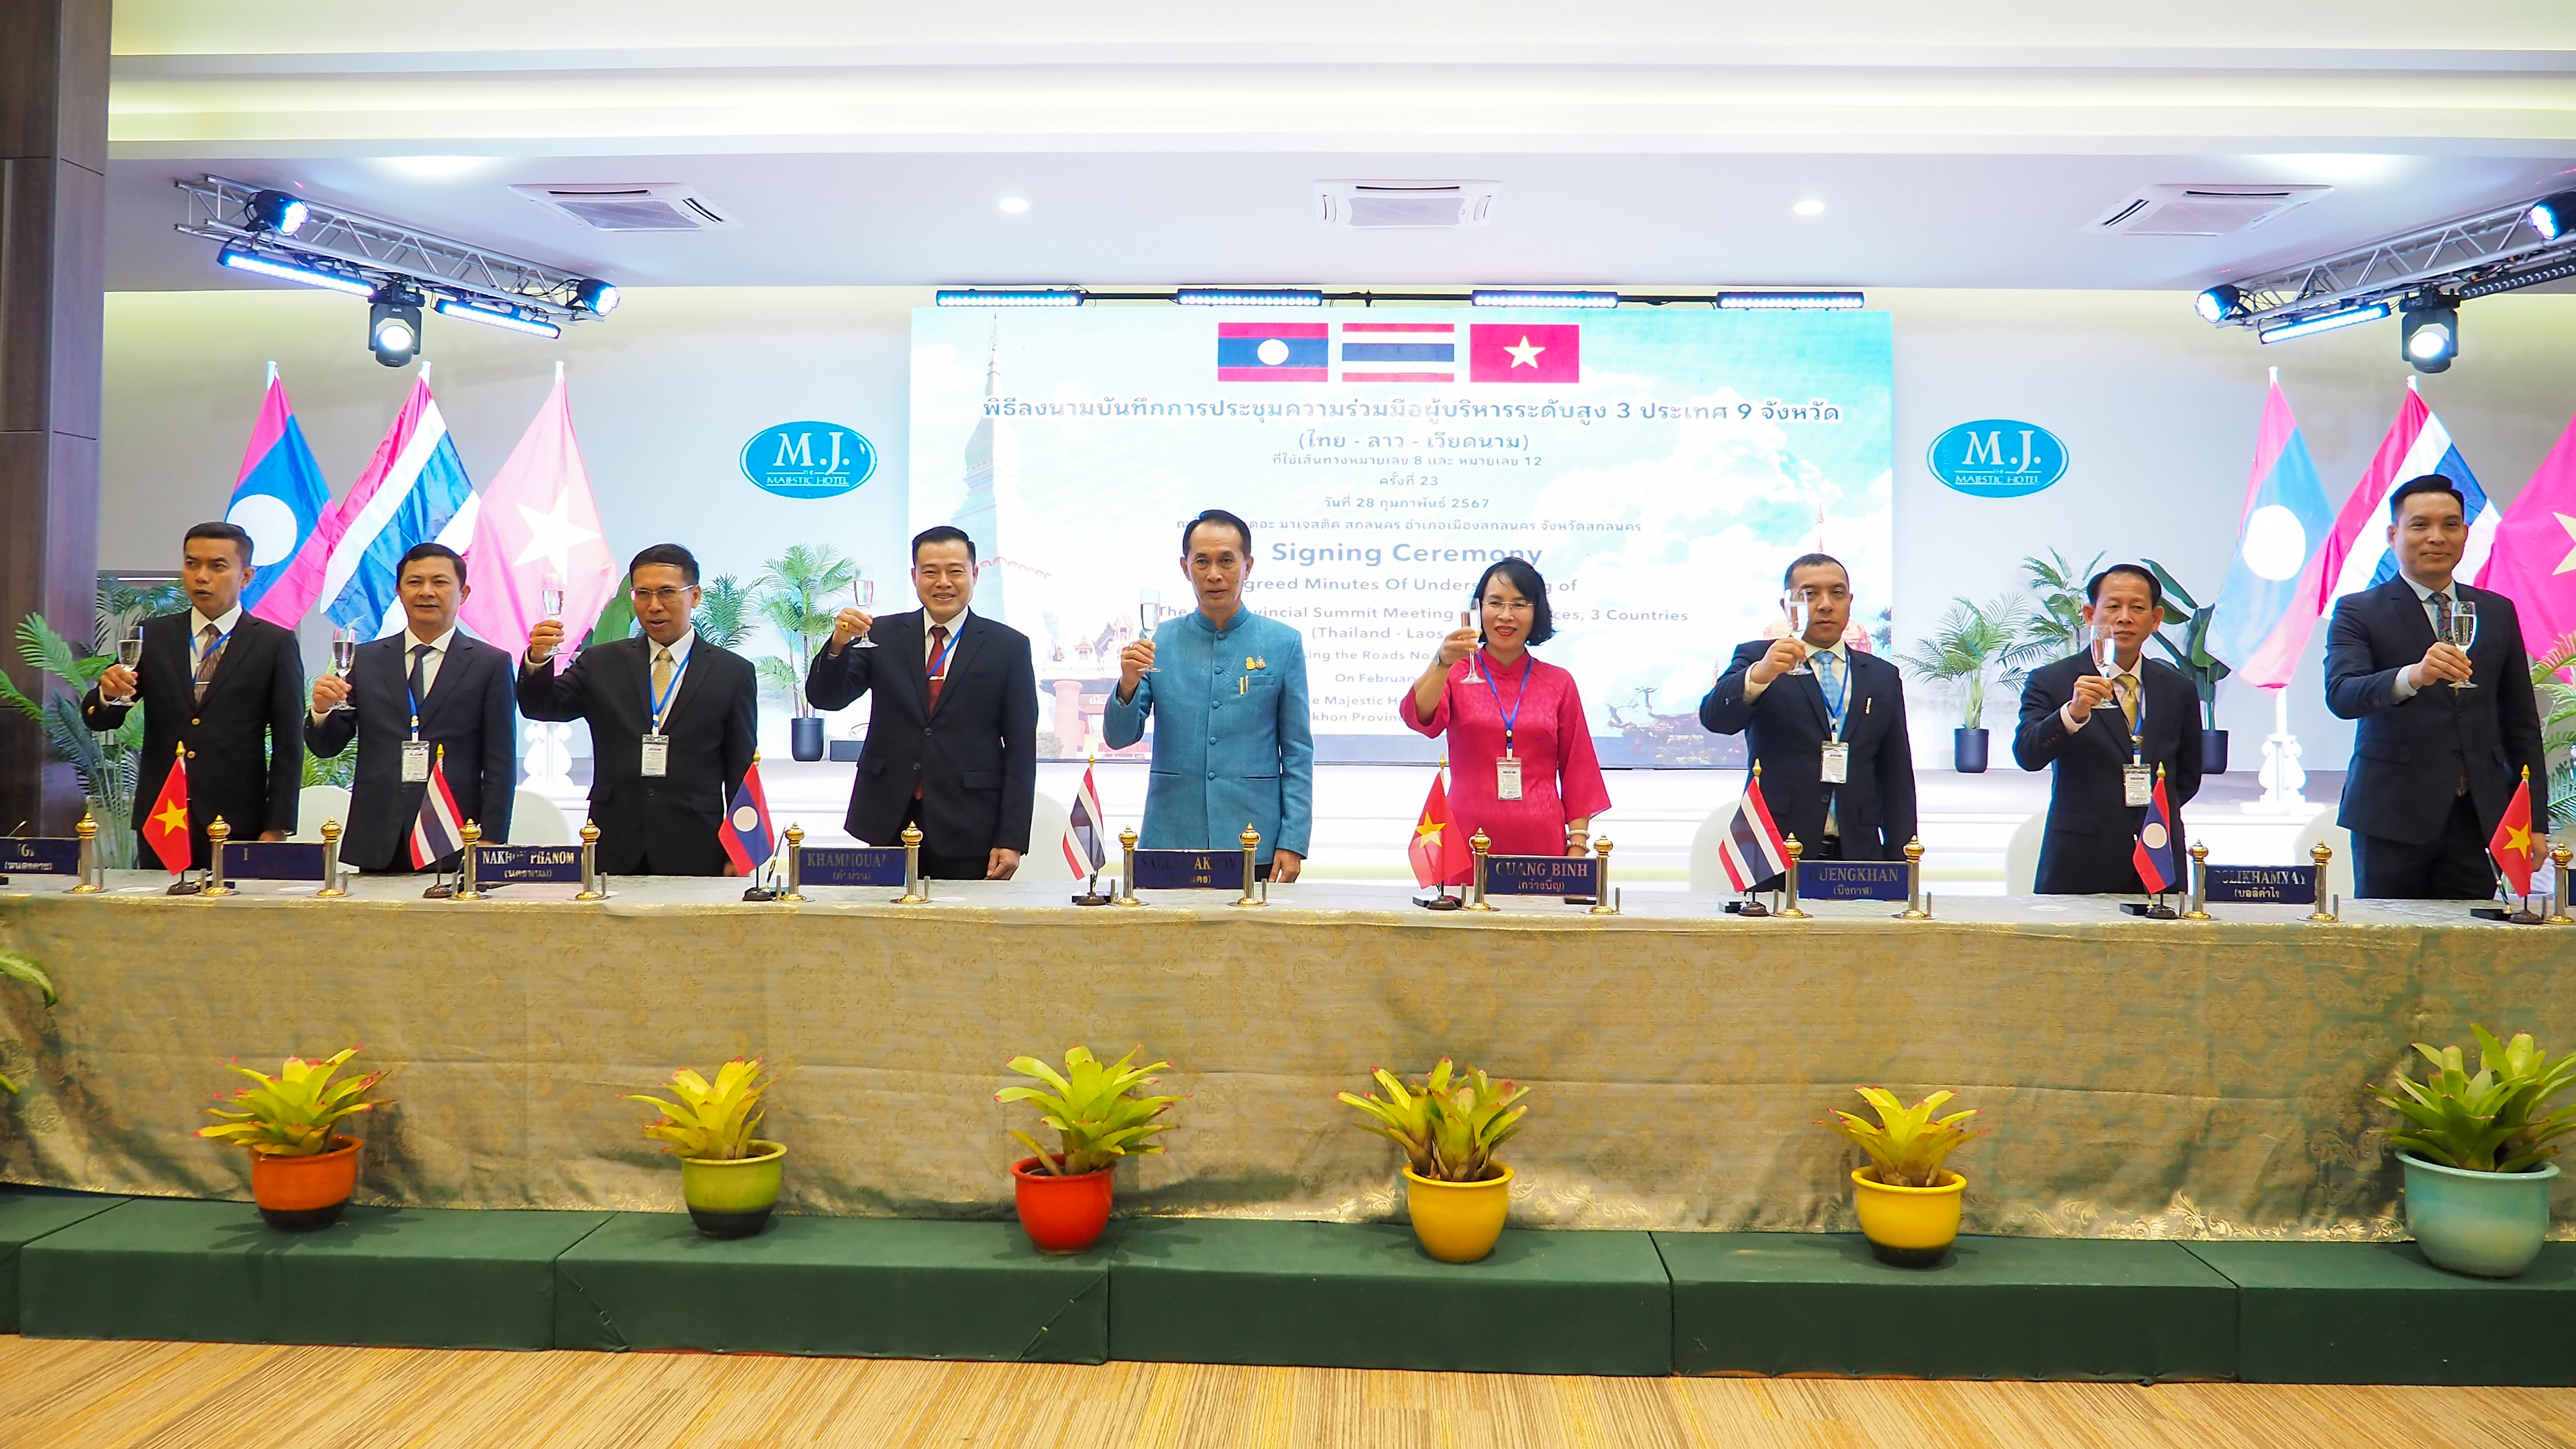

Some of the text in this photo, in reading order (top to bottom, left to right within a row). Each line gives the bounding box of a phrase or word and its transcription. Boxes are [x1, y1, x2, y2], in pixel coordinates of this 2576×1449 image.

[983, 397, 1839, 425] พิธีลงนามบันทึกการประชุมความร่วมมือผู้บริหารระดับสูง 3 ประเทศ 9 จังหวัด
[1299, 429, 1346, 450] (ไทย
[1368, 436, 1404, 448] ลาว
[1428, 431, 1529, 451] เวียดนาม)
[773, 431, 850, 476] M.J.
[1272, 451, 1542, 467] ที่ใช้เส้นทางหมายเลข 8 และ หมายเลข 12
[1961, 430, 2042, 474] M.J.
[1379, 472, 1438, 486] ครั้งที่ 23
[1324, 495, 1490, 512] วันที่ 28 กุมภาพันธ์ 2567
[1249, 520, 1276, 529] ดอะ
[1279, 518, 1340, 530] มาเจสติค
[1345, 521, 1400, 530] สกลนคร
[1405, 519, 1535, 531] อำเภอเมืองสกลนคร
[1541, 519, 1641, 532] จังหวัดสกลนคร
[1272, 542, 1542, 566] Signing Ceremony
[1244, 577, 1298, 592] greed
[1305, 577, 1379, 590] Minutes
[1385, 577, 1408, 590] Of
[1558, 579, 1578, 591] of
[1313, 607, 1377, 618] Summit
[1383, 607, 1453, 622] Meeting
[1591, 609, 1600, 620] 3
[1606, 609, 1688, 621] Countries
[1311, 626, 1391, 640] (Thailand
[1407, 628, 1444, 639] Laos
[1335, 650, 1357, 660] the
[1362, 650, 1405, 660] Roads
[1335, 673, 1354, 683] On
[1324, 695, 1383, 708] Majestic
[1312, 712, 1347, 722] khon
[483, 850, 525, 864] NAKH
[807, 853, 895, 867] KHAMMOUA
[1551, 862, 1588, 877] BINH
